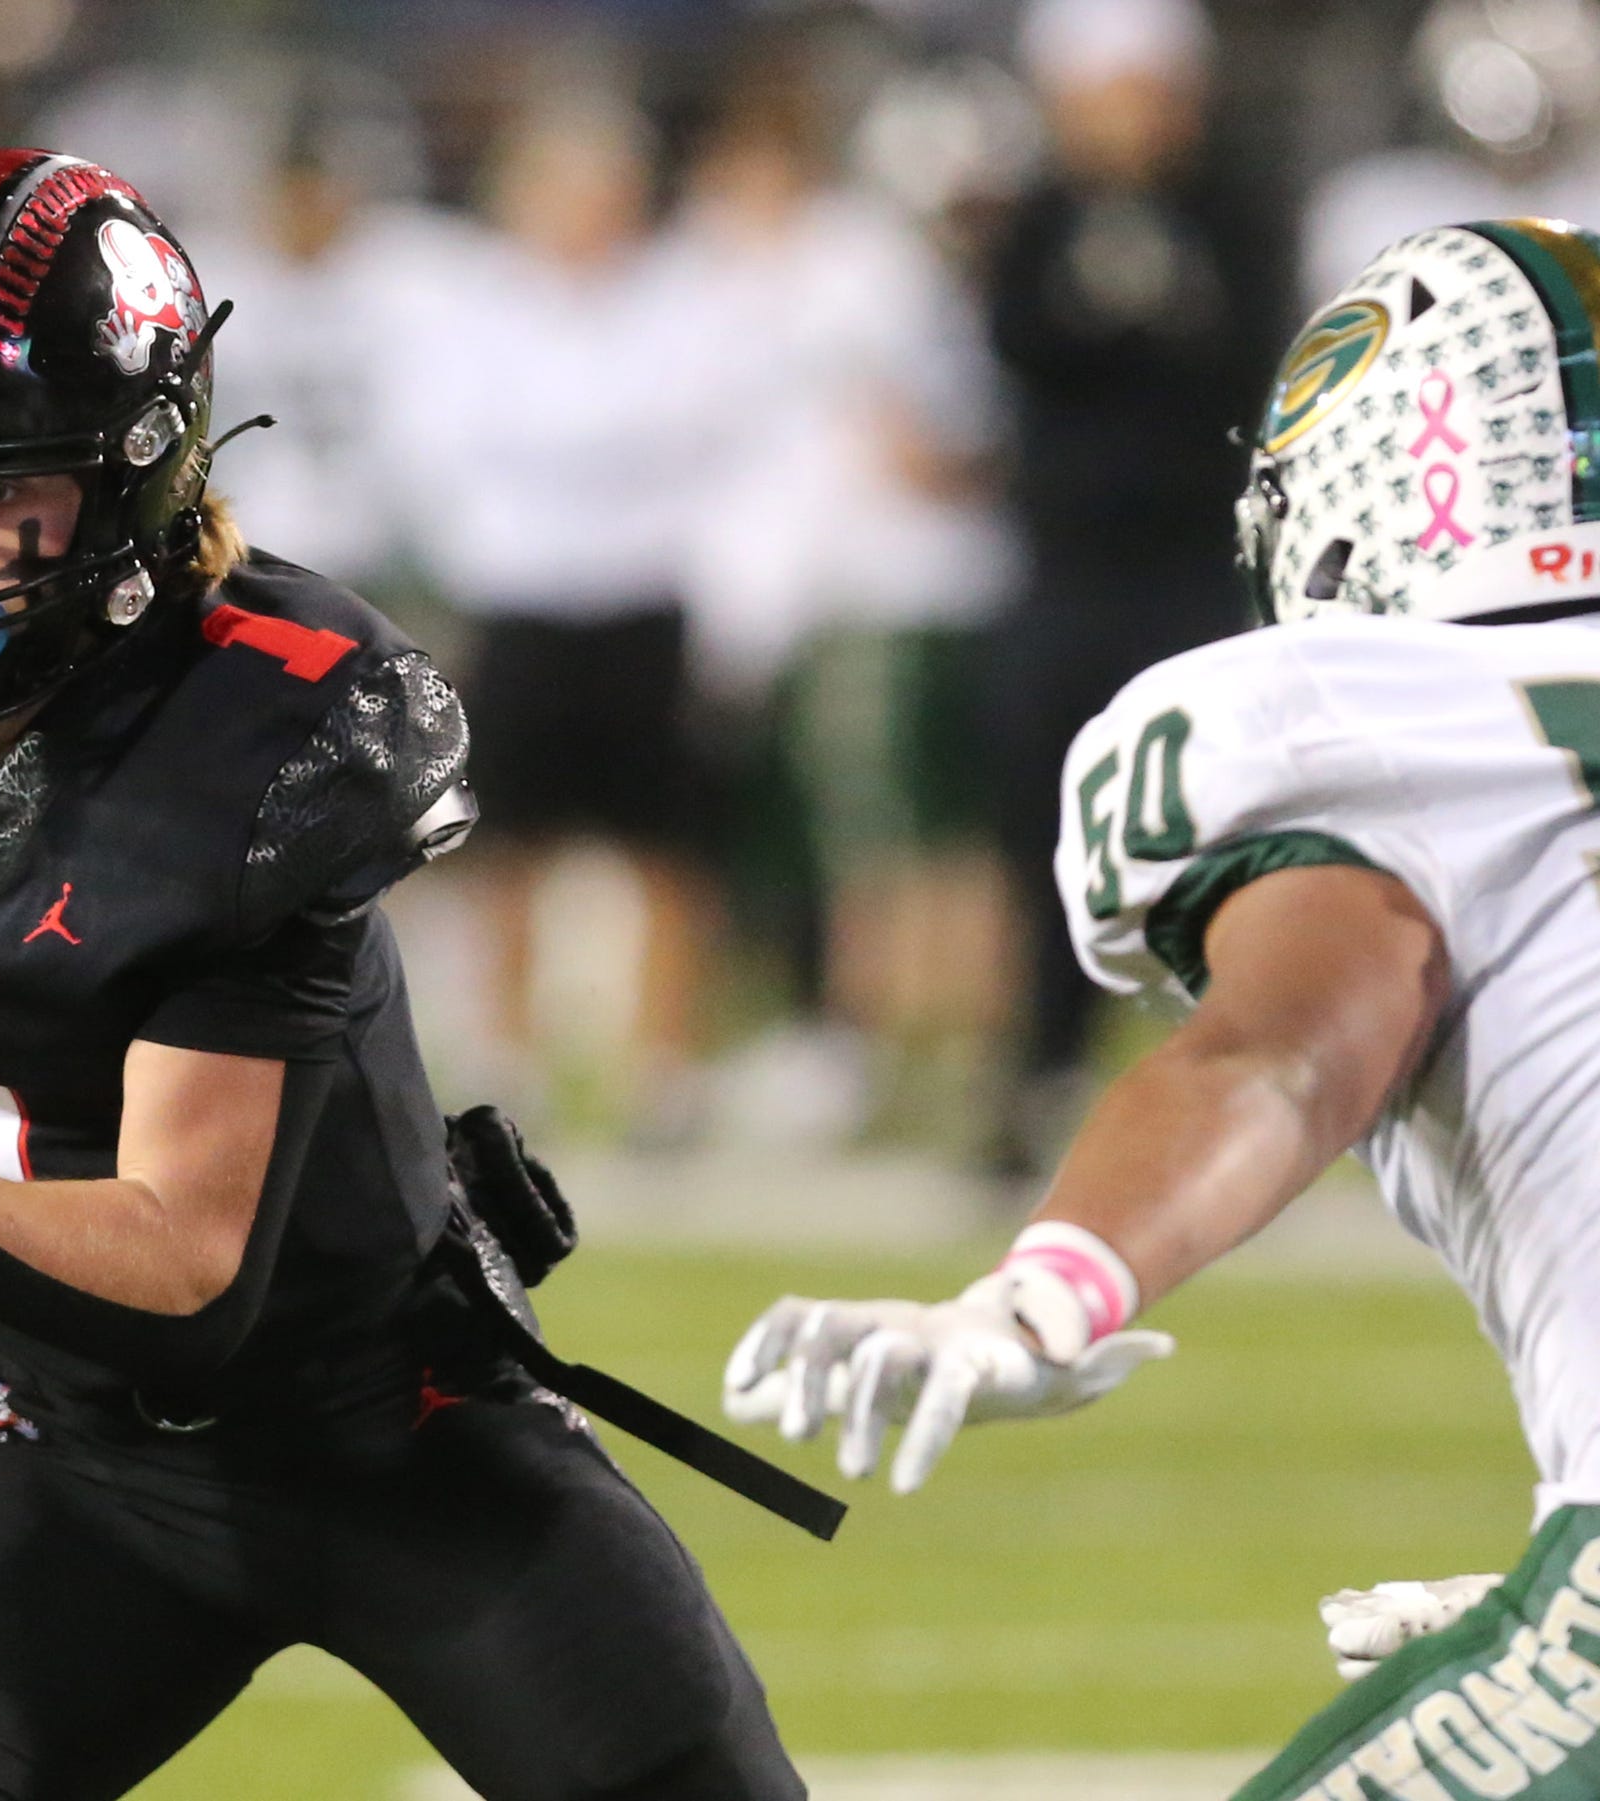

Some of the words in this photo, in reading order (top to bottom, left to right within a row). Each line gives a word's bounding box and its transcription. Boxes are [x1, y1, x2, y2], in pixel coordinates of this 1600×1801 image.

[1528, 542, 1600, 582] RI
[202, 603, 359, 683] 1
[1077, 704, 1196, 920] 50
